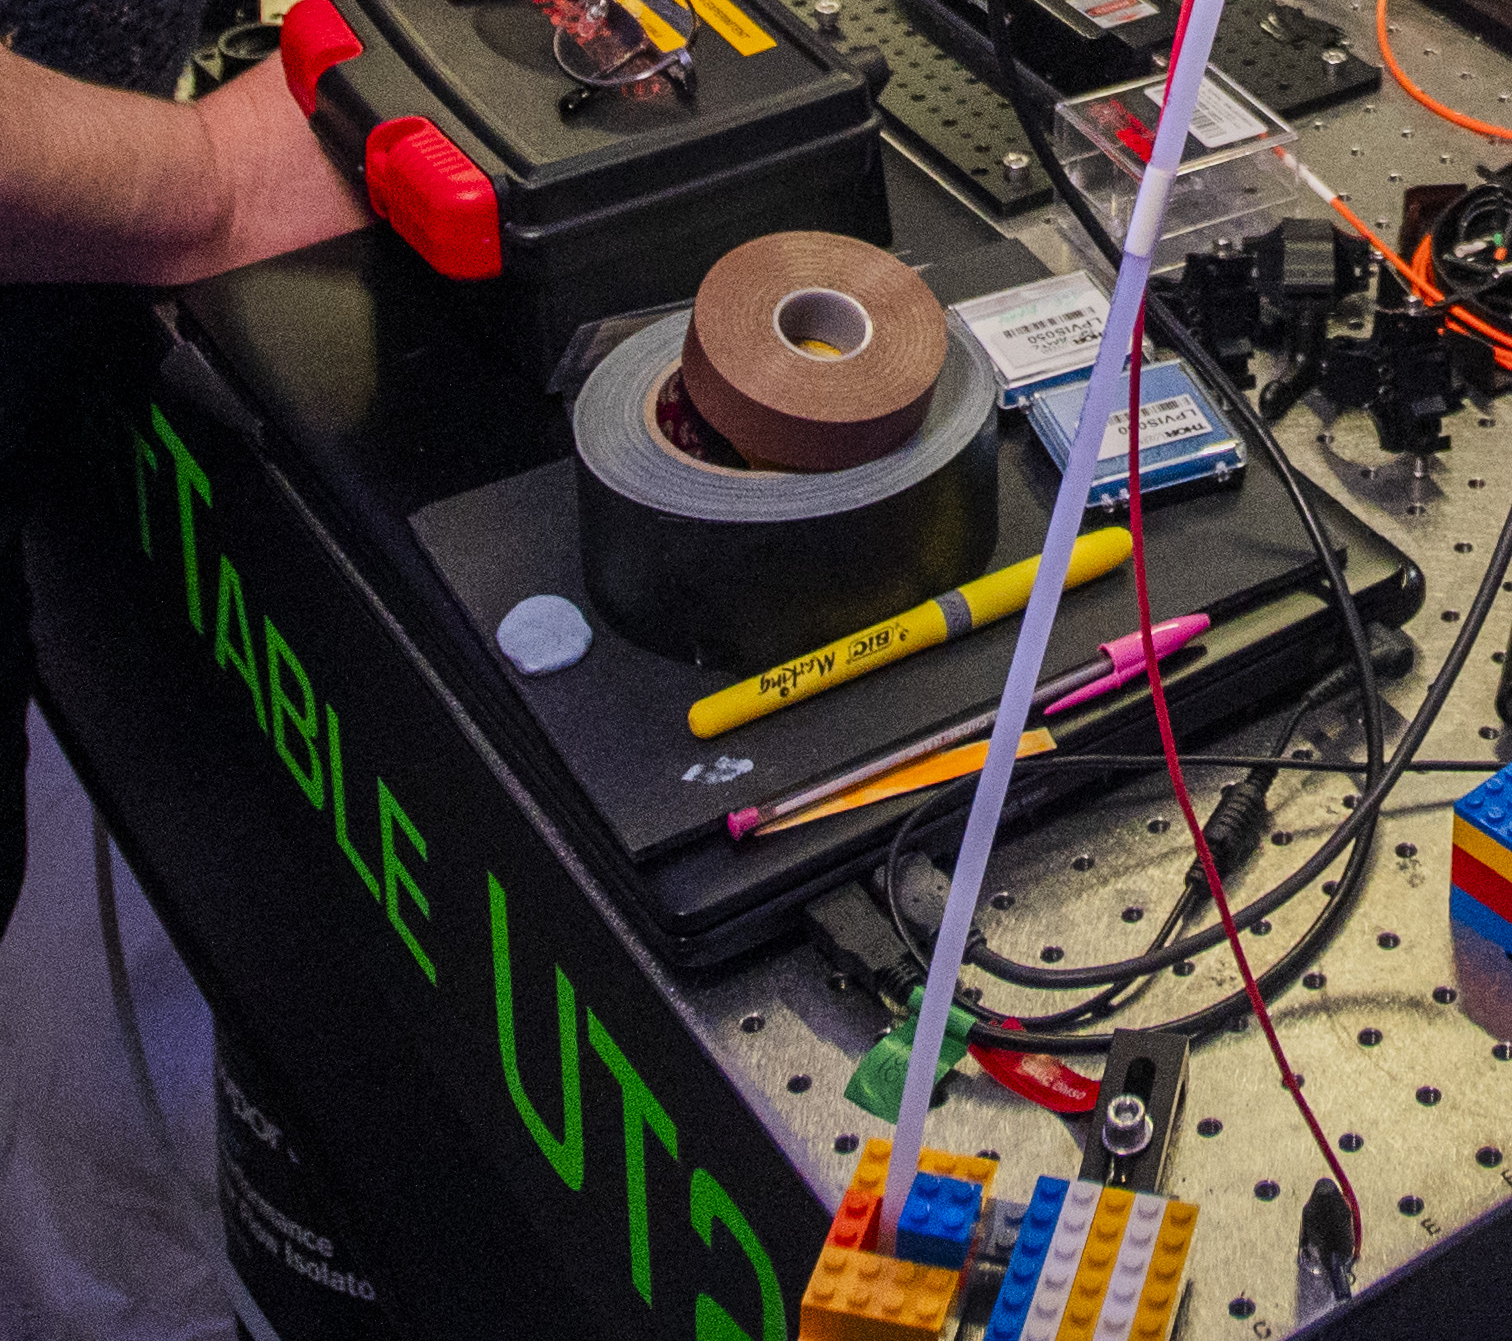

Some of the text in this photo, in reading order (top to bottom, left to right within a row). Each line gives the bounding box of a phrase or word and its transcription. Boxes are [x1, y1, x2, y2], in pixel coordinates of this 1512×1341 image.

[1027, 317, 1102, 344] LPVIS050
[1117, 406, 1198, 436] LPVIS00
[759, 630, 890, 698] BIC Marking
